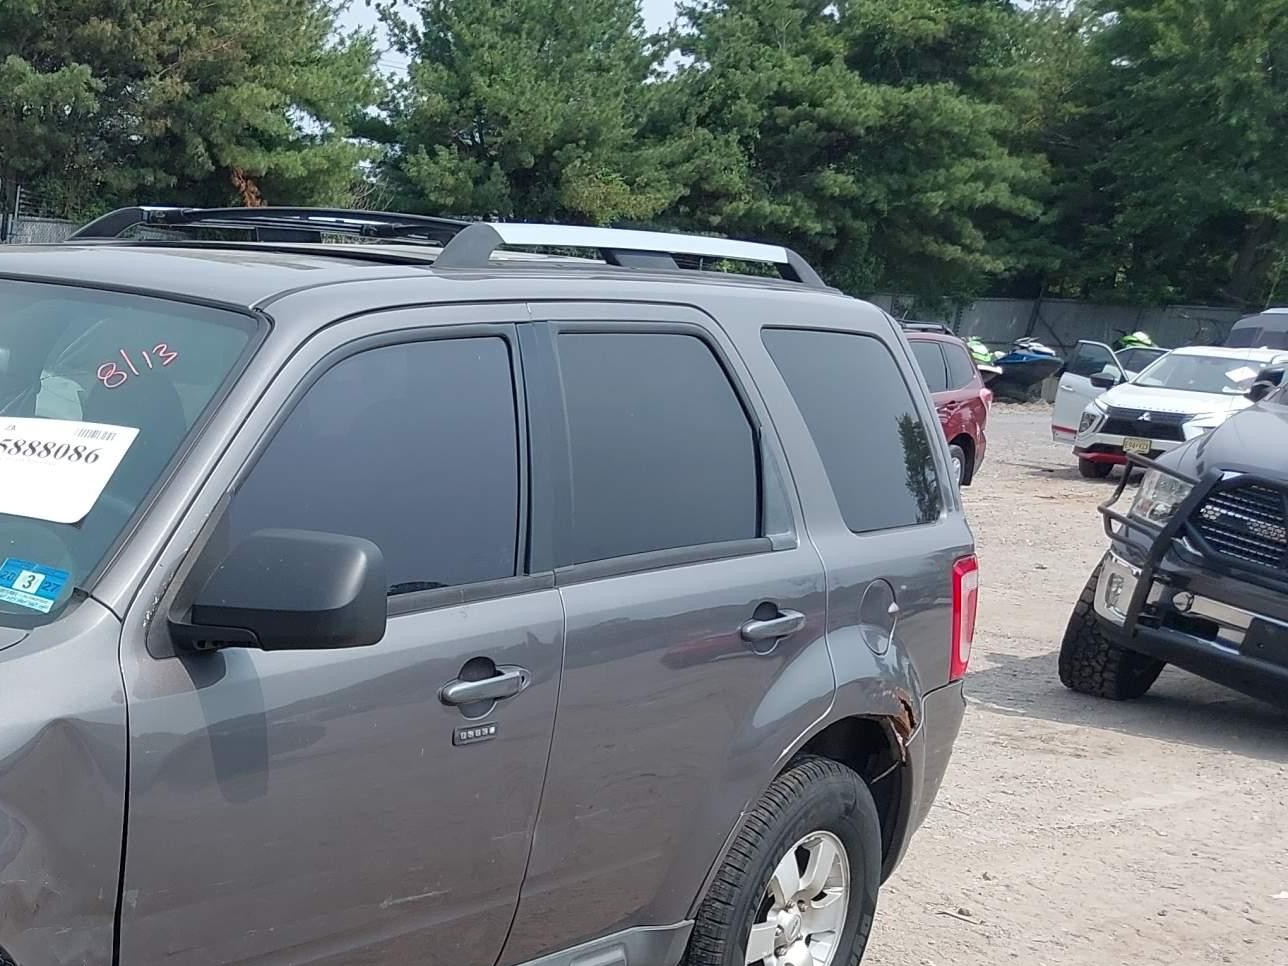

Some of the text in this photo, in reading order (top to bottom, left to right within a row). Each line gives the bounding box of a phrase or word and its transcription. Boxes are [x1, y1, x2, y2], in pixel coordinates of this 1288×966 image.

[0, 570, 62, 592] 20 3 27
